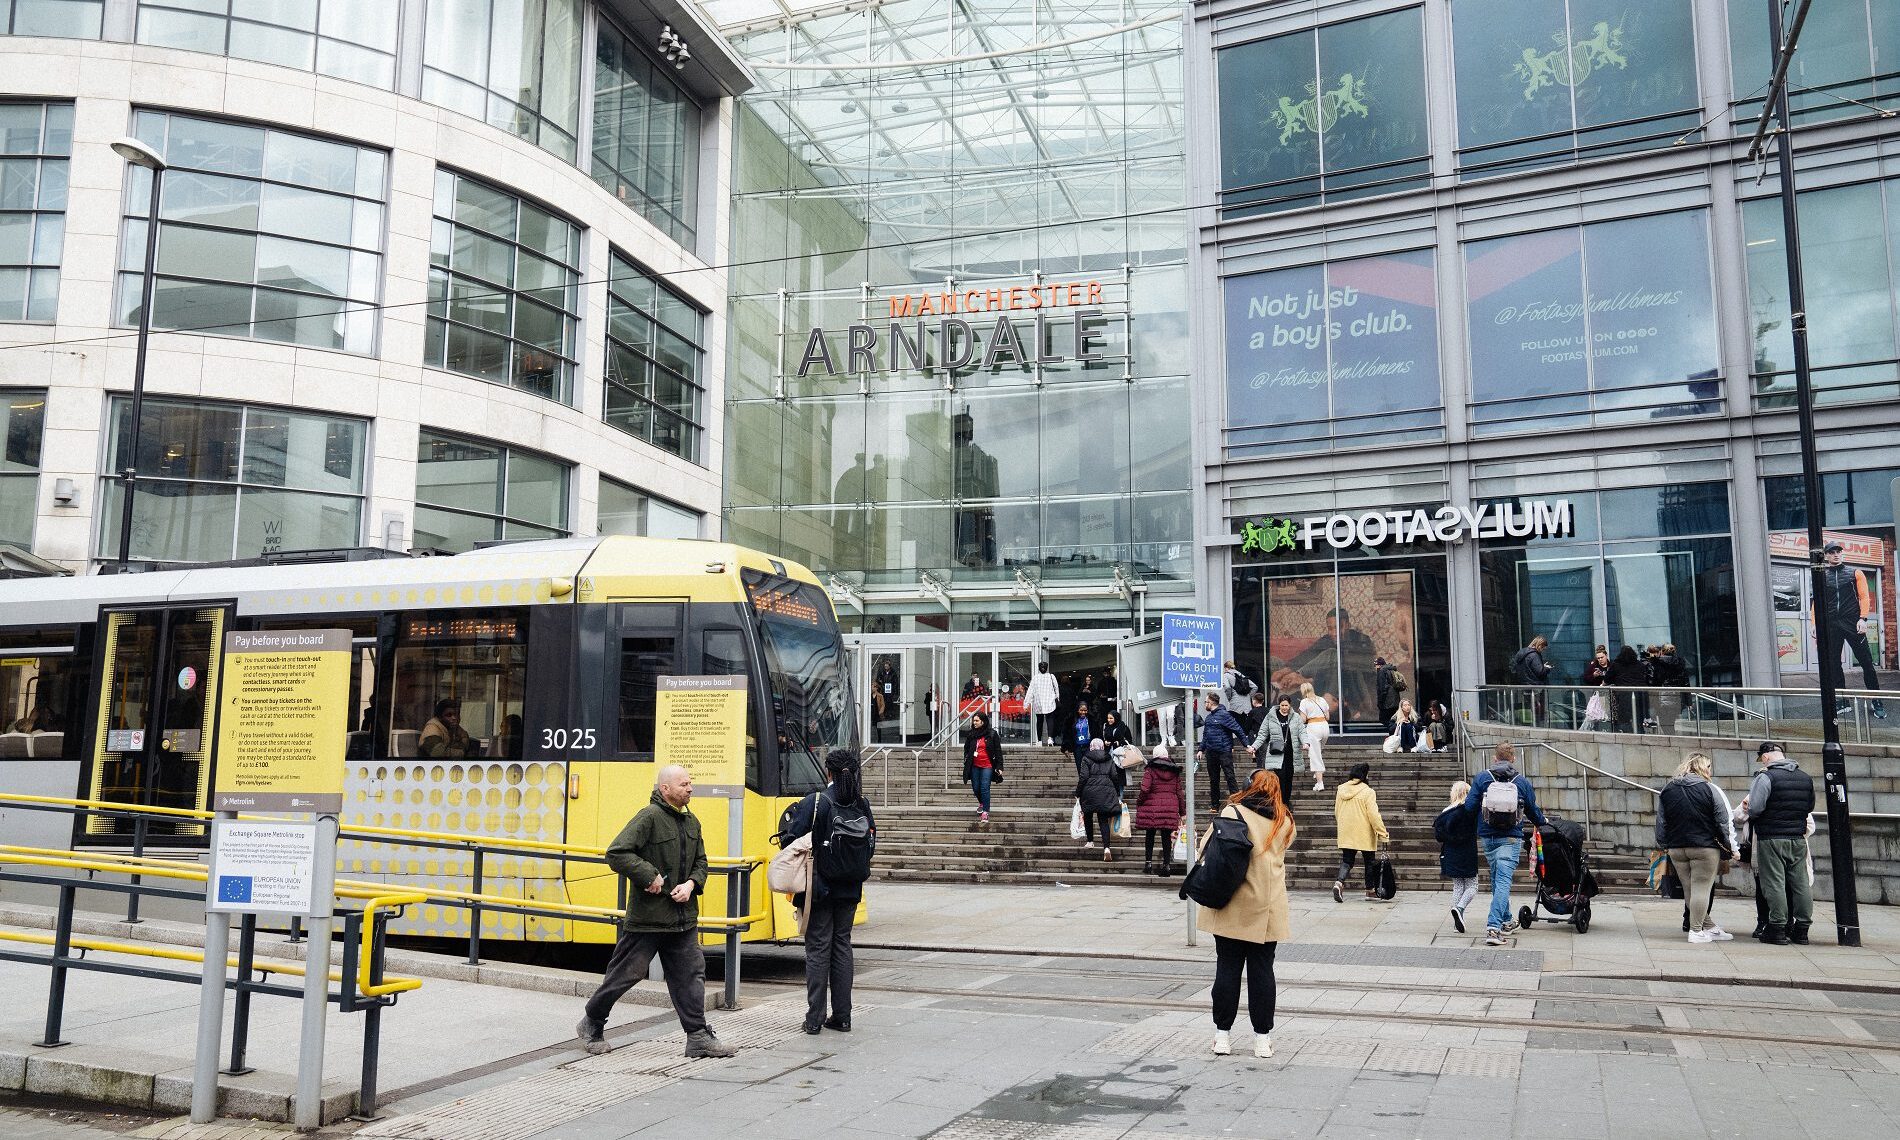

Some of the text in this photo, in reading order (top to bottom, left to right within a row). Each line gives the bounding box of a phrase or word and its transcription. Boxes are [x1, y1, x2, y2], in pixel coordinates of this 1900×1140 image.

[890, 282, 1102, 317] MANCHESTER
[1248, 286, 1358, 319] Not just
[1250, 310, 1412, 349] a boy's club.
[797, 310, 1102, 377] ARNDALE
[1522, 338, 1571, 350] FOLLOW
[1594, 332, 1612, 342] ON
[1304, 500, 1570, 549] FOOTASYLUM
[1171, 618, 1215, 630] TRAMWAY
[235, 634, 324, 648] Pay before you board
[1167, 661, 1218, 673] LOOK BOTH
[667, 679, 677, 688] Pay
[1181, 674, 1205, 682] WAYS
